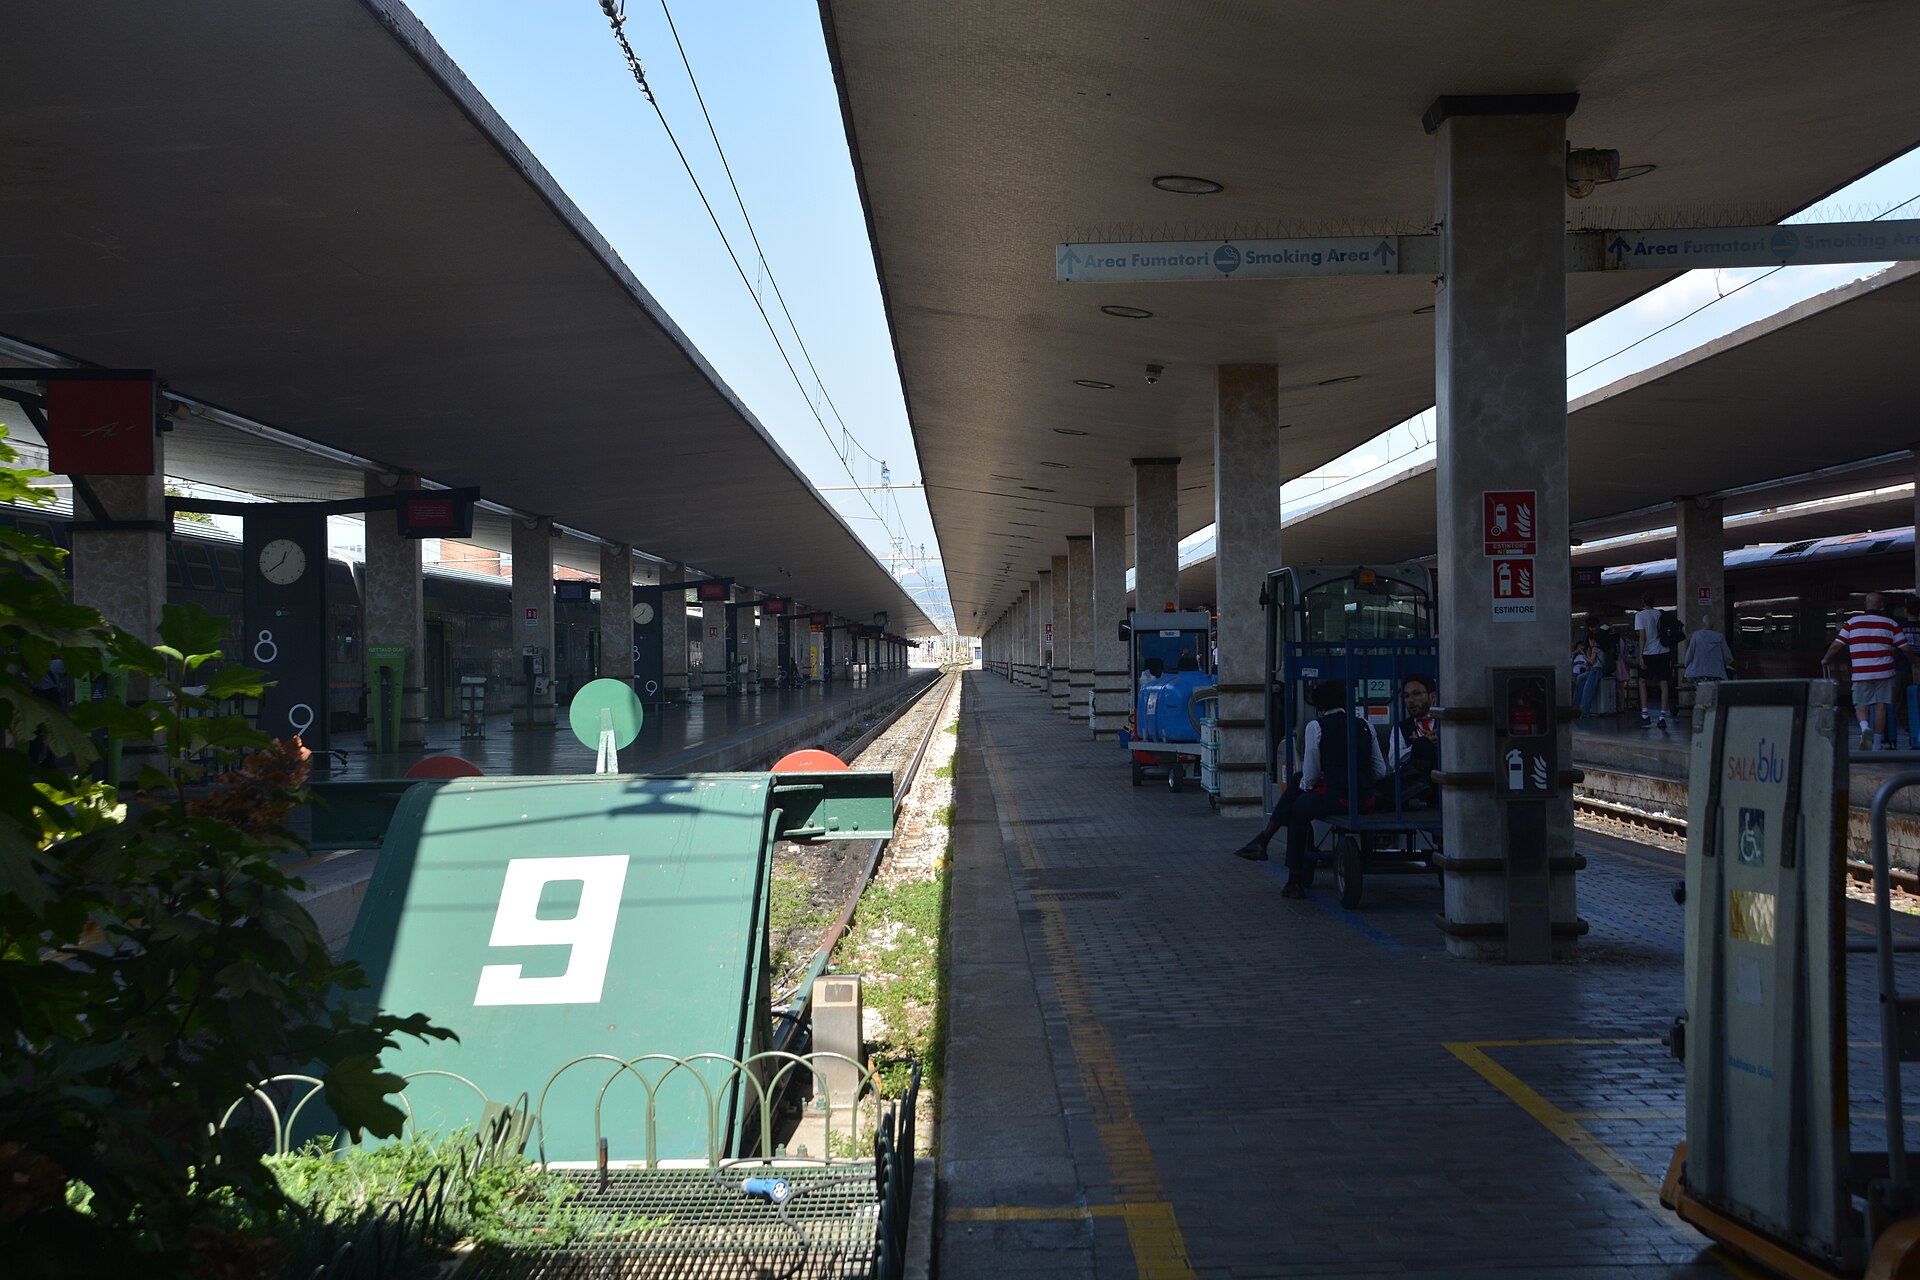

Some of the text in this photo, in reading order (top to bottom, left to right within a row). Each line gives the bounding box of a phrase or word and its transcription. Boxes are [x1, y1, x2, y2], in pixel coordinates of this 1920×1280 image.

[1684, 237, 1764, 254] Fumatori
[1804, 233, 1886, 249] Smoking
[1084, 248, 1369, 268] Area Fumatori Smoking Area
[1494, 605, 1535, 614] ESTINTORE
[254, 629, 278, 663] 8
[645, 680, 658, 697] 9
[1370, 680, 1385, 691] 22
[288, 703, 314, 737] 9
[473, 854, 630, 1006] 9
